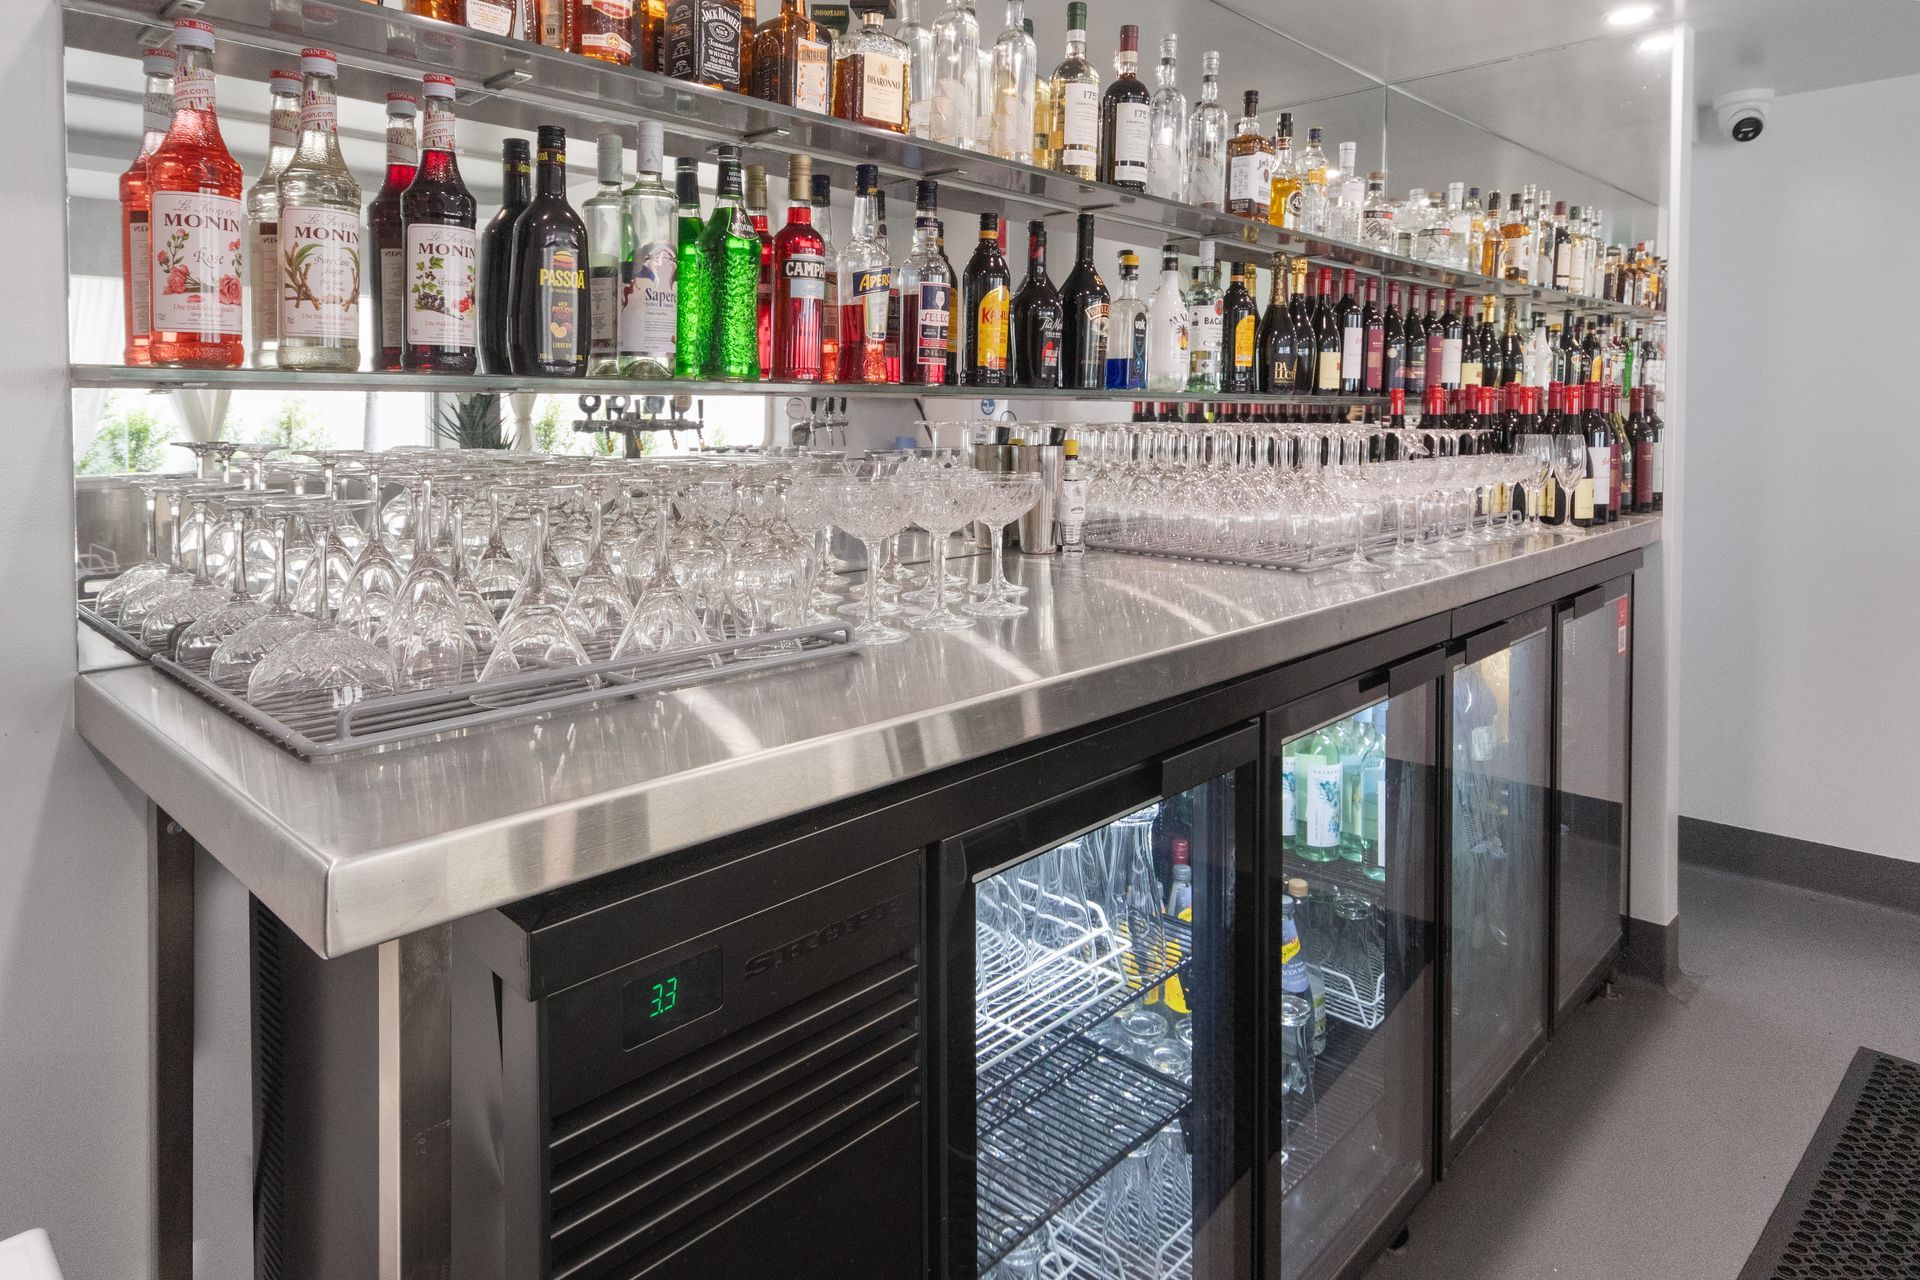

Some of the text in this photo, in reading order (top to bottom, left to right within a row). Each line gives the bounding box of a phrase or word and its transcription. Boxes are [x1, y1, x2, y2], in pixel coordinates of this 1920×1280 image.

[708, 37, 735, 53] Tennessee
[708, 49, 735, 61] WHISKEY
[867, 74, 900, 90] DISARONNO
[164, 213, 240, 233] MONIN
[294, 226, 359, 244] MONIN
[193, 247, 224, 268] Rose
[418, 243, 476, 259] MONIN
[539, 268, 585, 289] PASSOÃ
